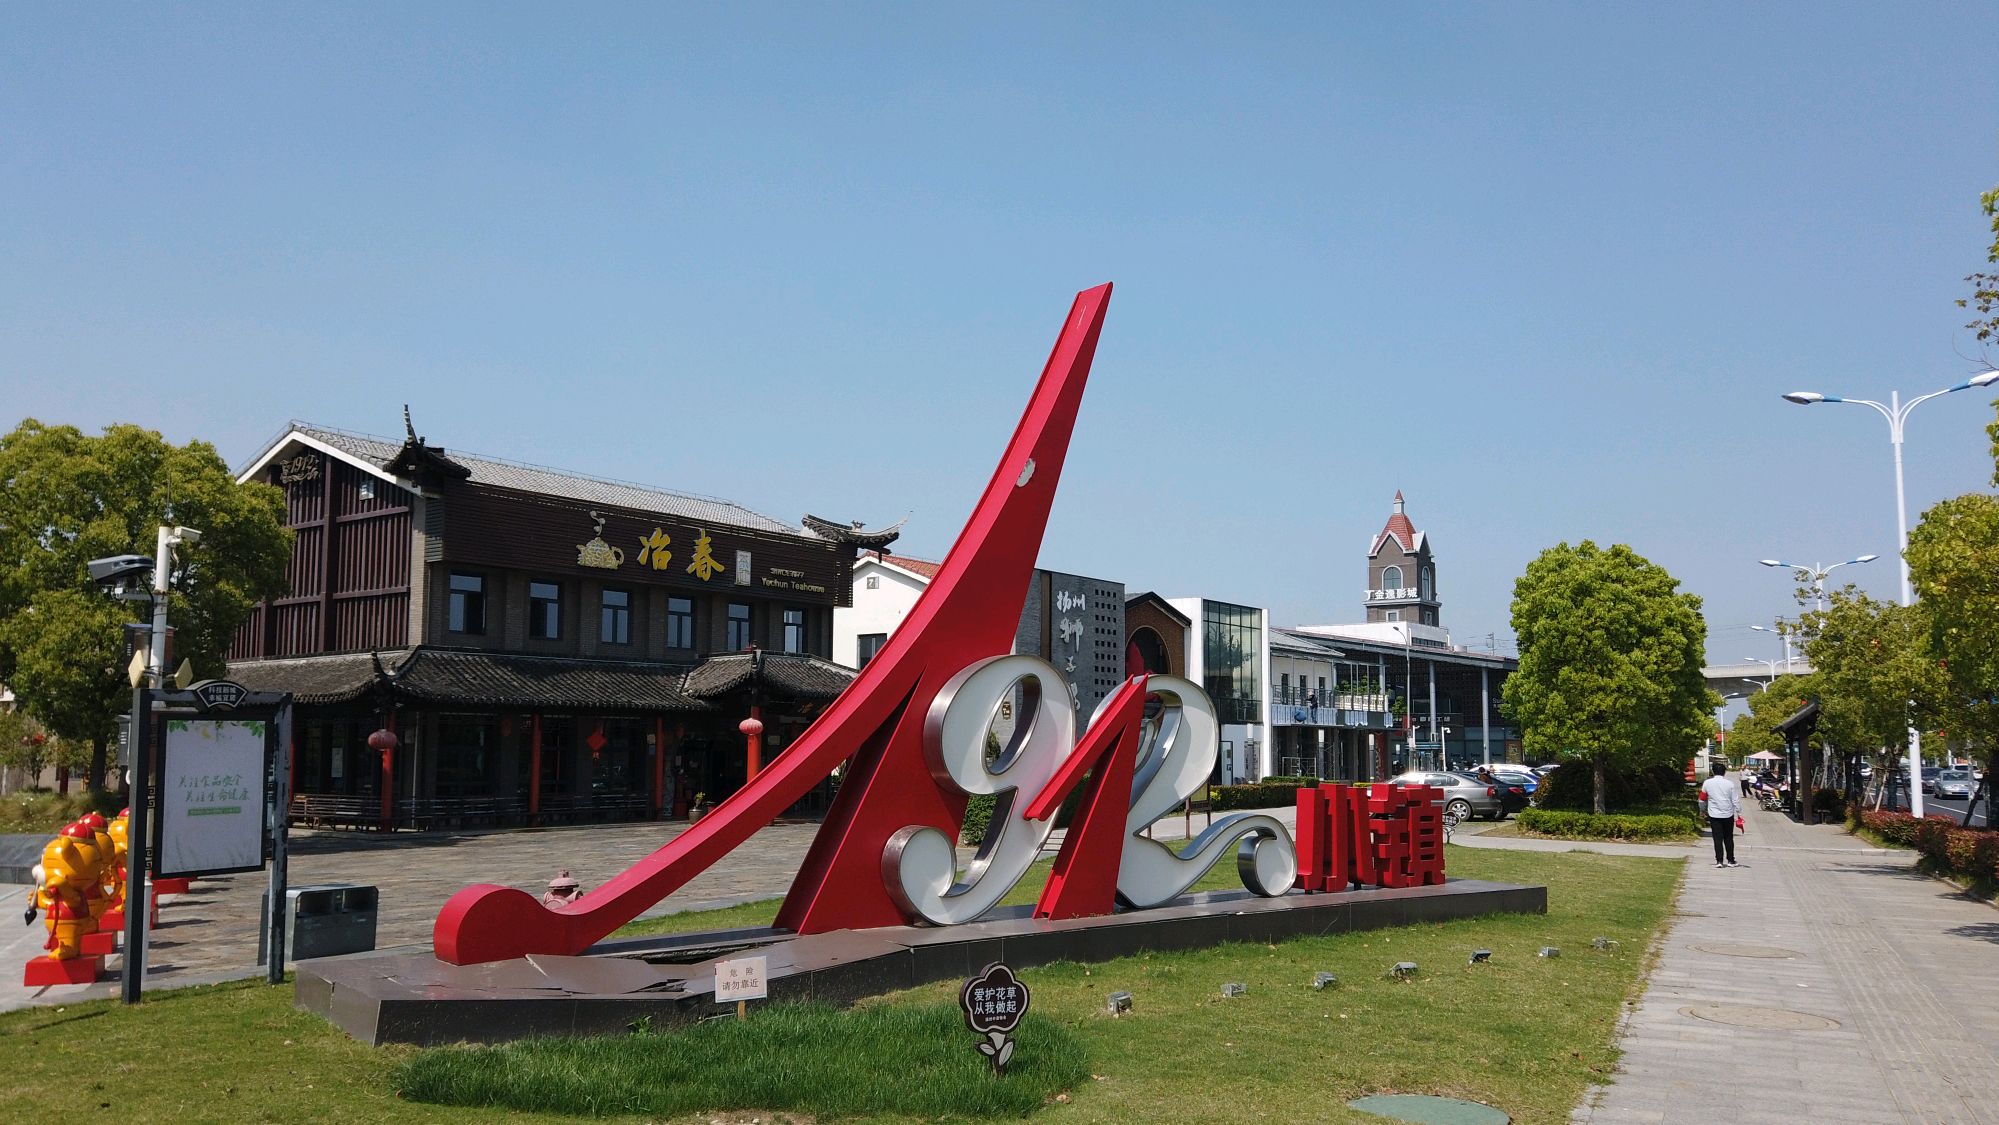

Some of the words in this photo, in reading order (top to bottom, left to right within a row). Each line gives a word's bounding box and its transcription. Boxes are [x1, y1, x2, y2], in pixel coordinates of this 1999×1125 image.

[637, 526, 725, 582] 冶春
[1057, 590, 1086, 613] 扬州
[433, 282, 1297, 967] 1912
[1295, 783, 1446, 894] 小镇
[730, 966, 754, 978] 危险
[722, 978, 760, 991] 请勿靠近
[974, 986, 1017, 1002] 爱护花草
[974, 1000, 1017, 1015] 从我做起
